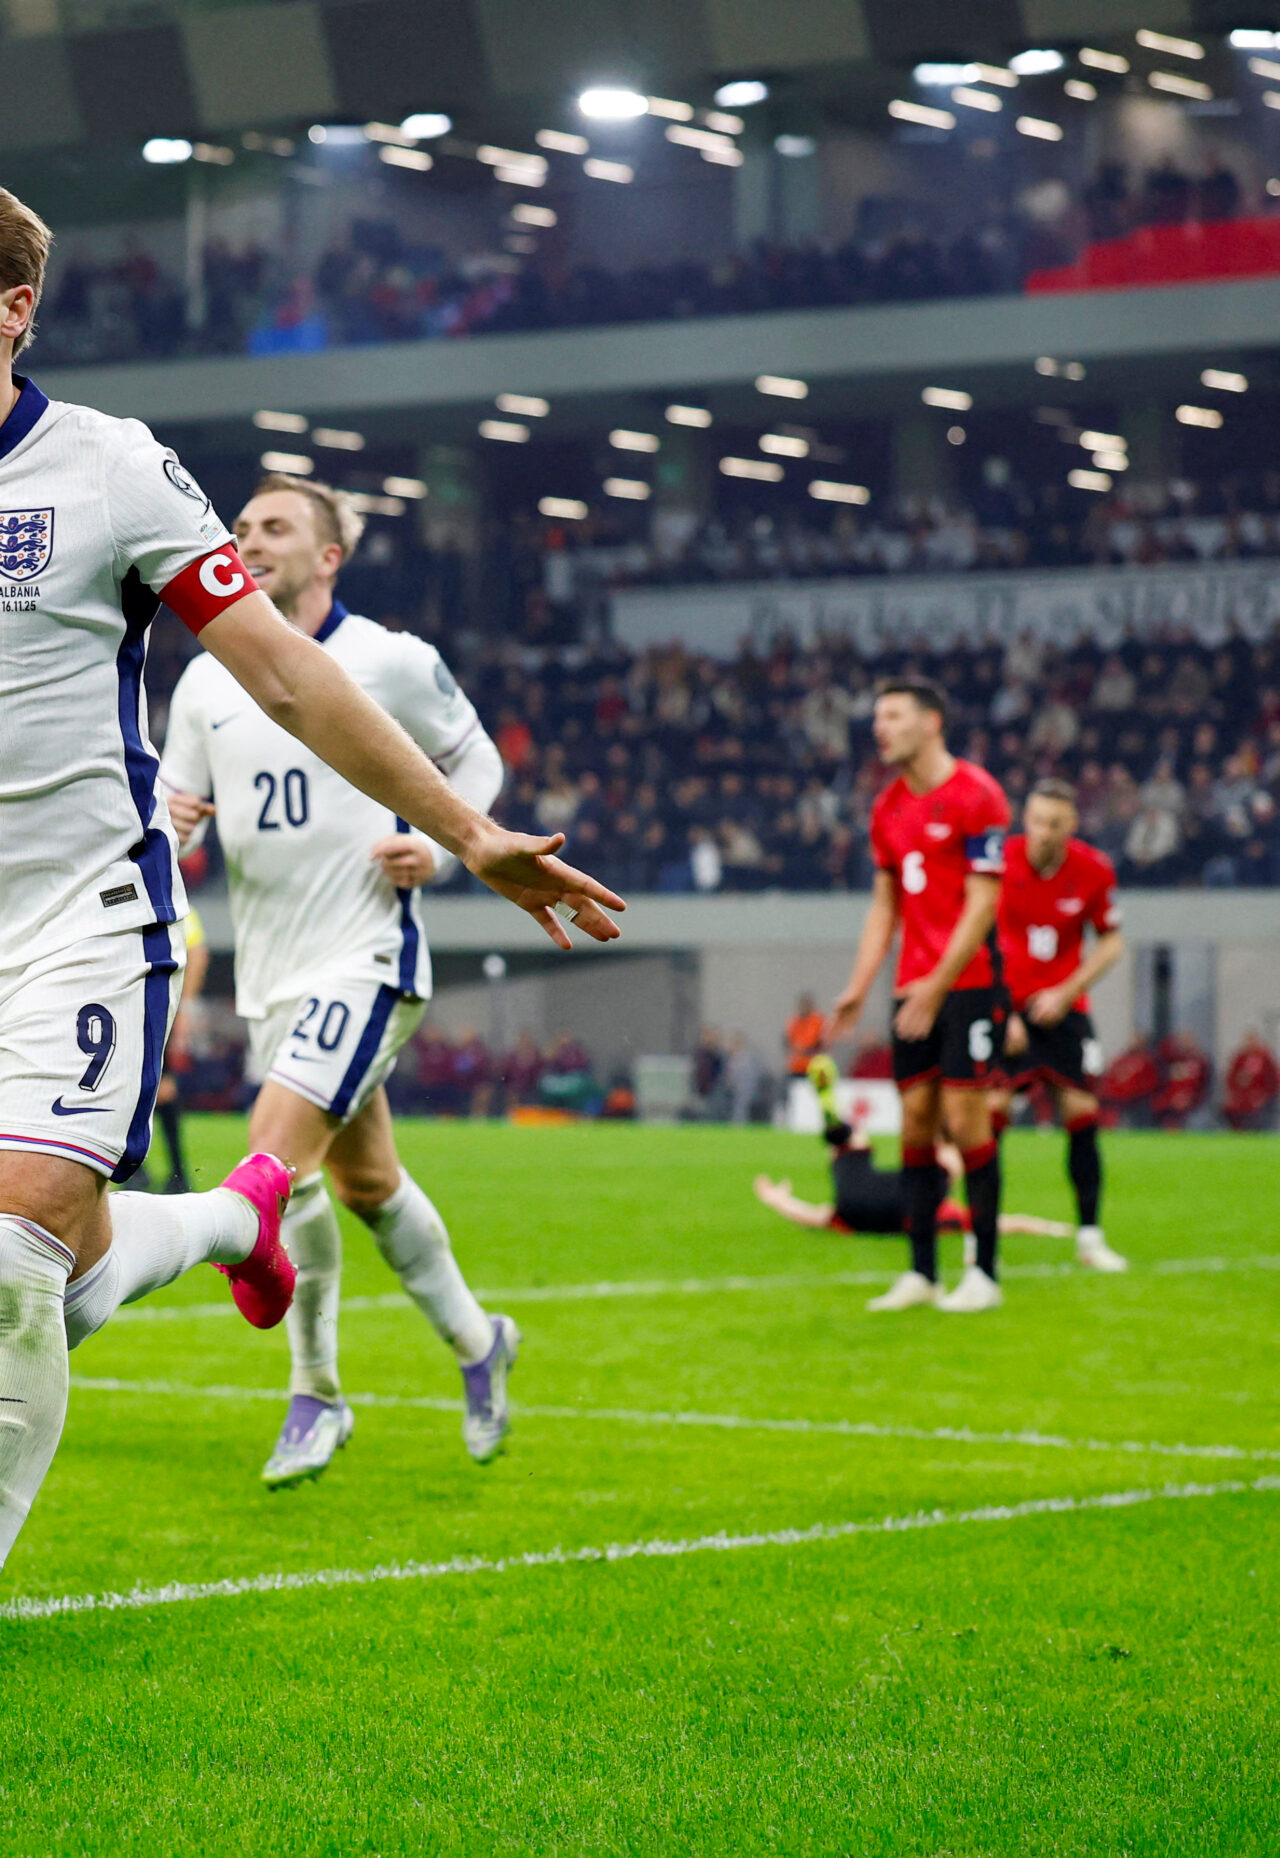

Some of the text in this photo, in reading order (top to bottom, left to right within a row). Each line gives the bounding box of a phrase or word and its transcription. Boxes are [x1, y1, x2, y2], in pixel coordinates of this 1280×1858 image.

[198, 553, 246, 598] C
[1, 600, 37, 612] 16.11.25
[254, 768, 309, 832] 20
[901, 851, 927, 894] 6
[76, 1003, 117, 1092] 9
[291, 998, 351, 1052] 20
[968, 1018, 993, 1062] 6
